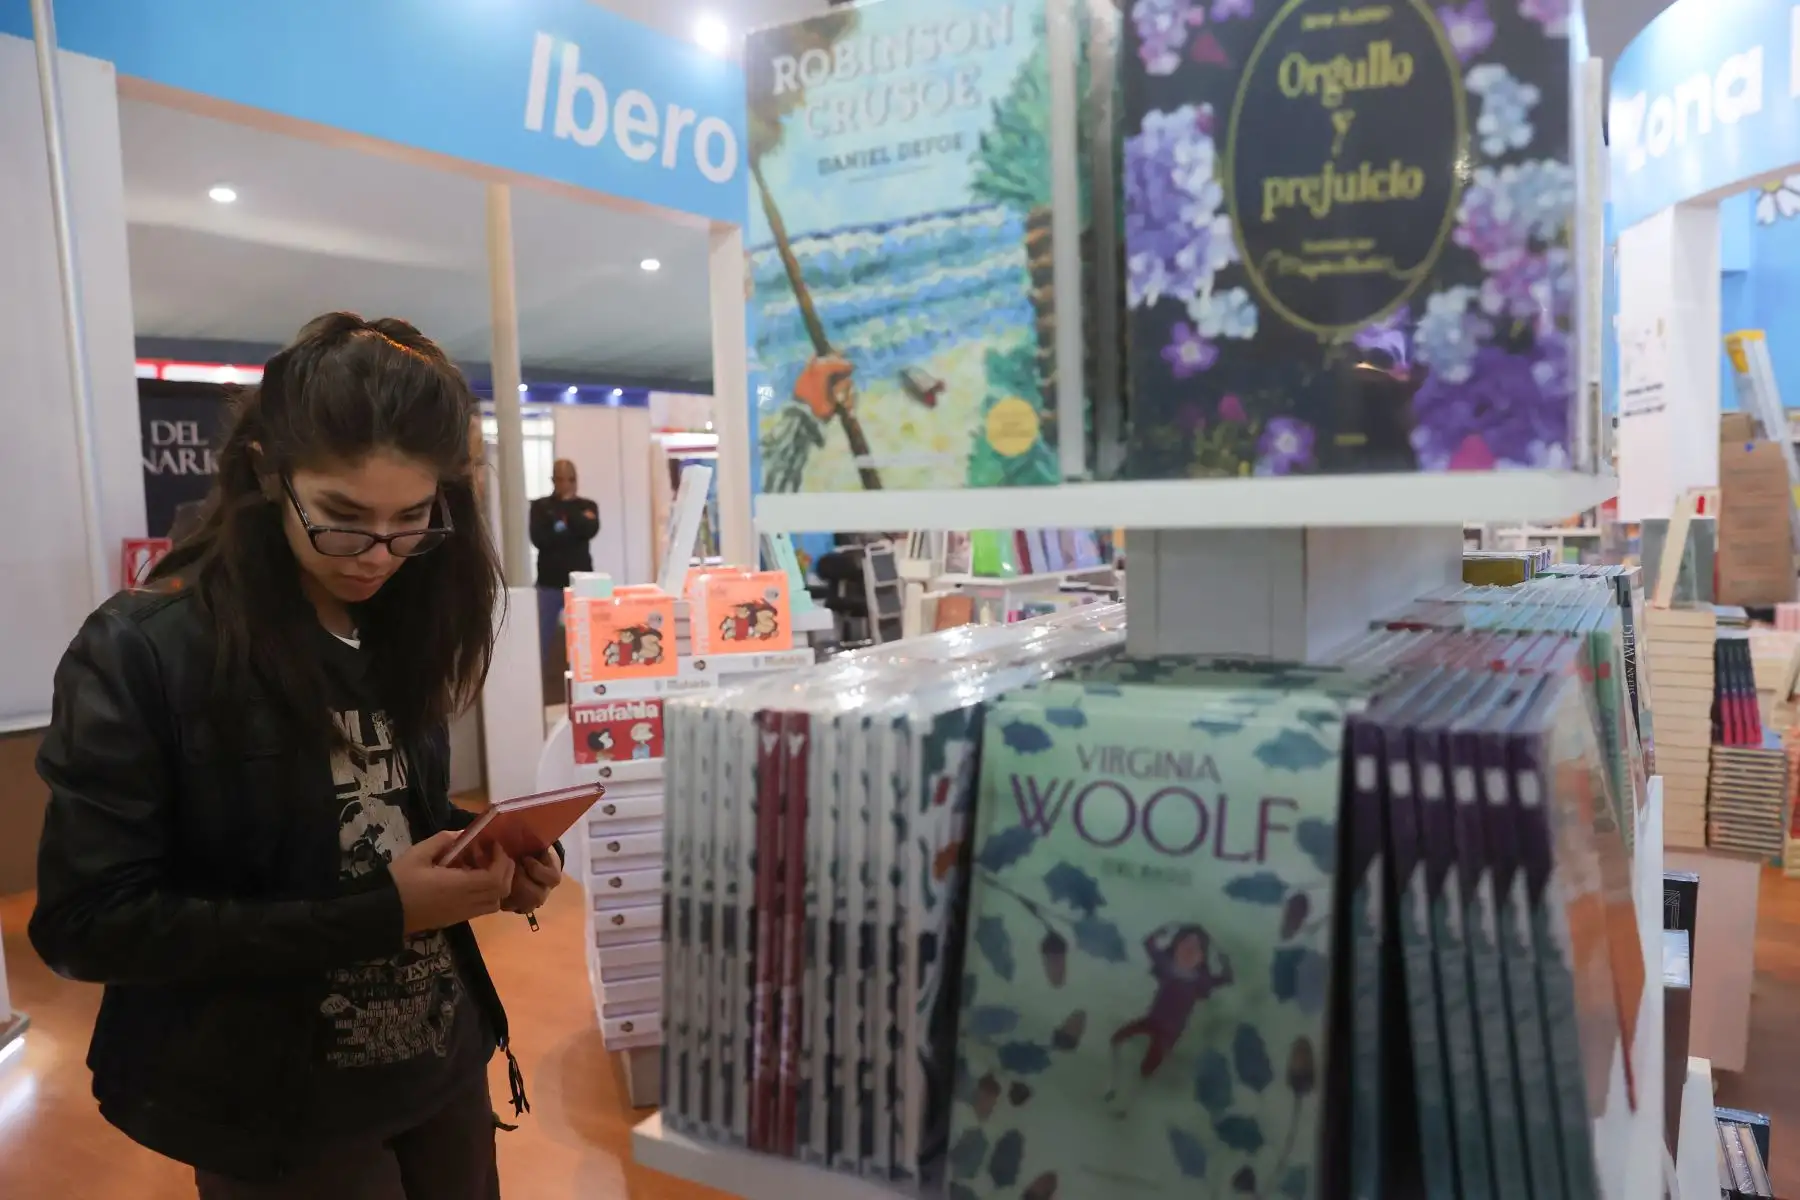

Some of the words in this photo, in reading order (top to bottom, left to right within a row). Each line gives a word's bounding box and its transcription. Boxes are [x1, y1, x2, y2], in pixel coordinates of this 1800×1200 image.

[771, 5, 1014, 95] ROBINSON
[1277, 39, 1413, 108] Orgullo
[524, 31, 738, 184] Ibero
[804, 65, 983, 138] CRUSOE
[817, 145, 891, 175] DANIEL
[897, 131, 965, 162] DEFOE
[1261, 159, 1425, 223] prejuicio
[150, 420, 209, 446] DEL
[575, 702, 659, 724] mafalda
[1075, 744, 1222, 785] VIRGINIA
[1009, 773, 1300, 865] WOOLF
